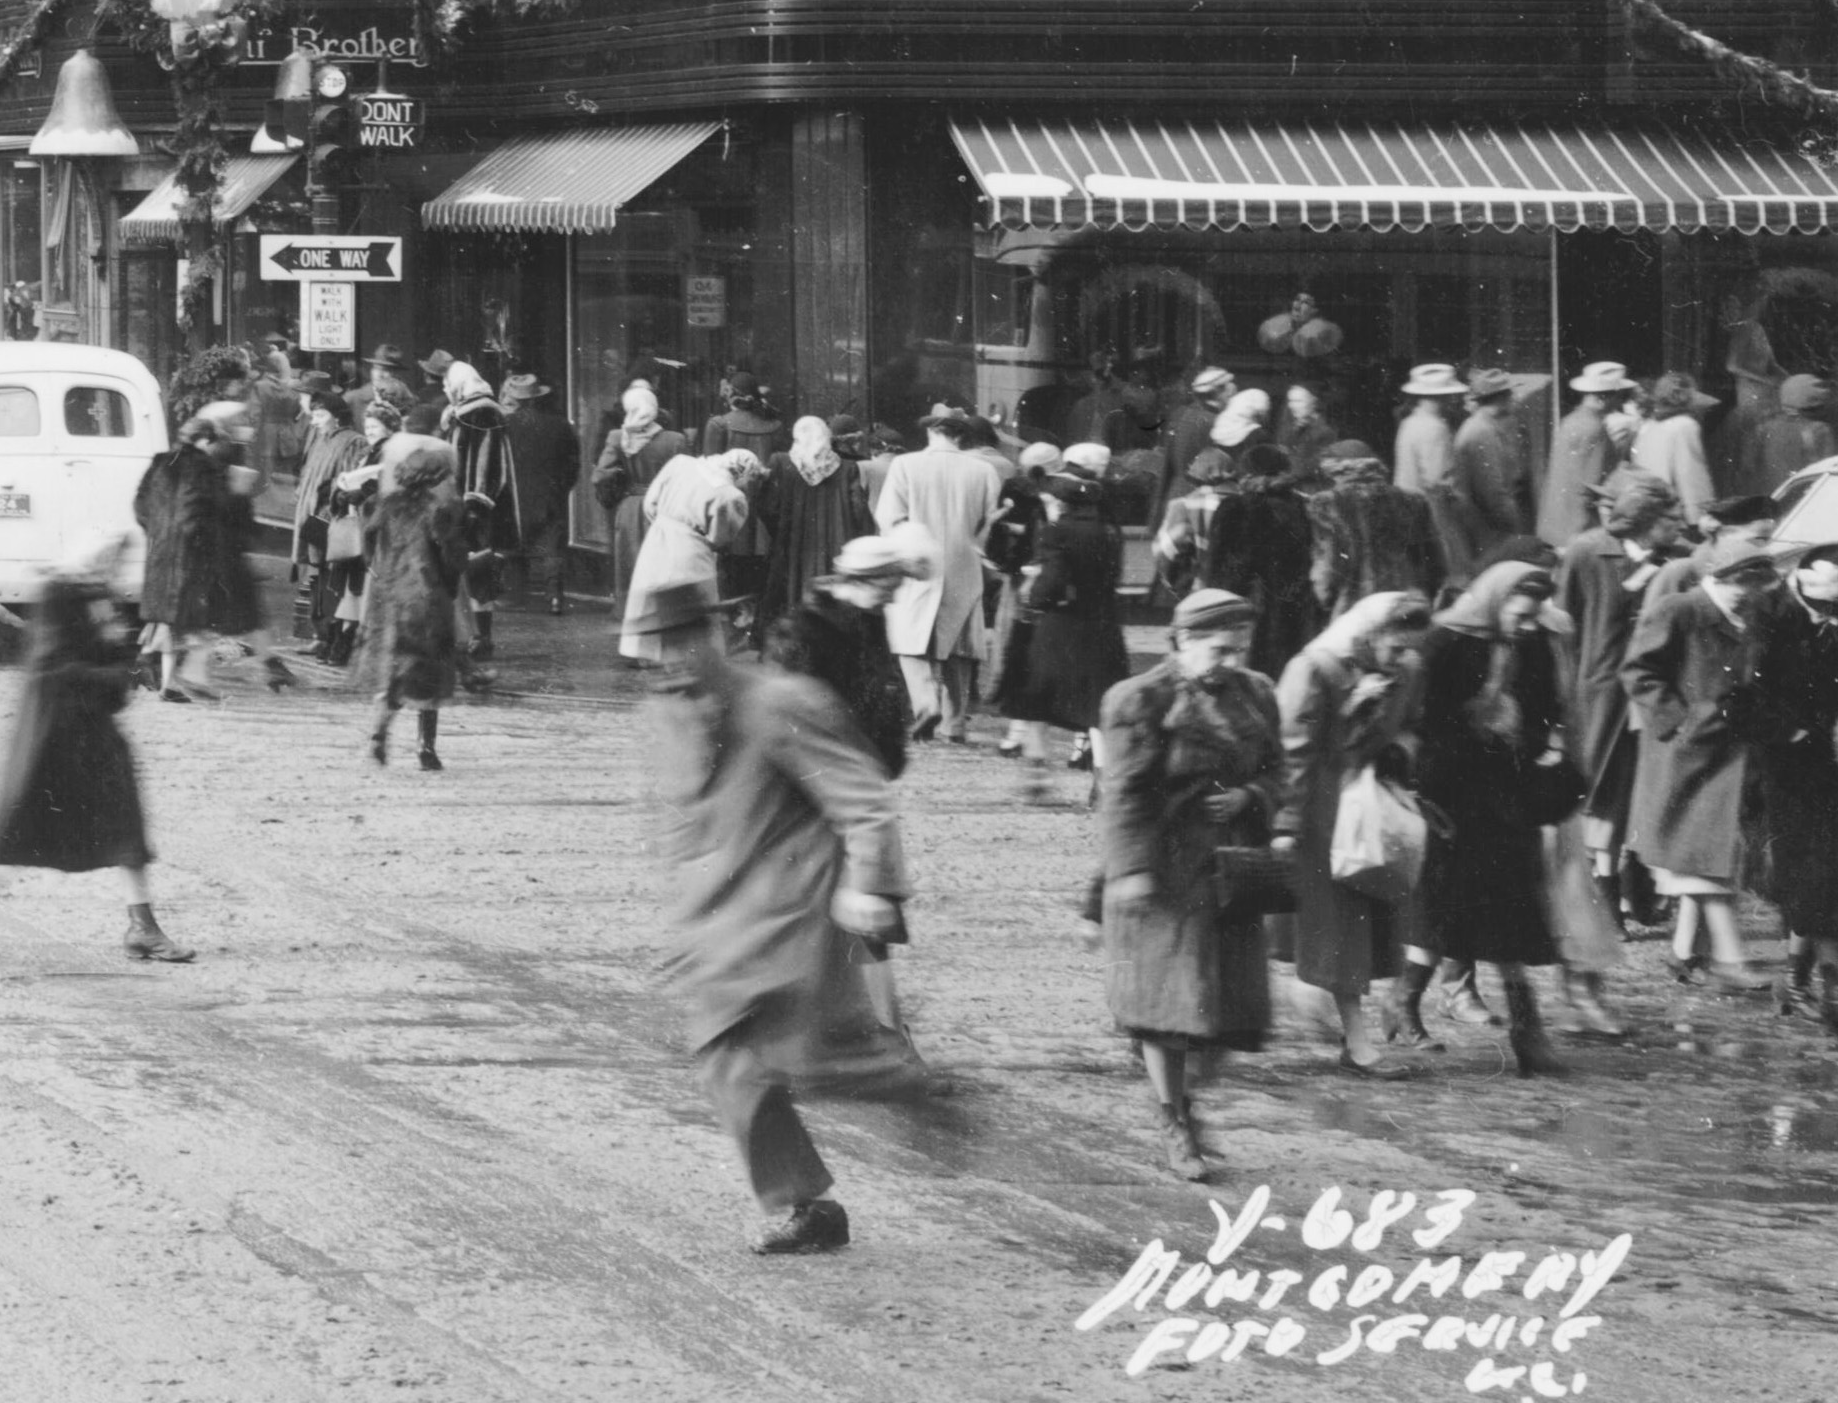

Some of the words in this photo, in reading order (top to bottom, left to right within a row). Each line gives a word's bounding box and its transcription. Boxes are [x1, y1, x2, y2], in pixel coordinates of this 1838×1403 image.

[360, 125, 415, 147] WALK
[299, 249, 332, 268] ONE
[339, 249, 371, 269] WAY
[314, 309, 347, 323] WALK
